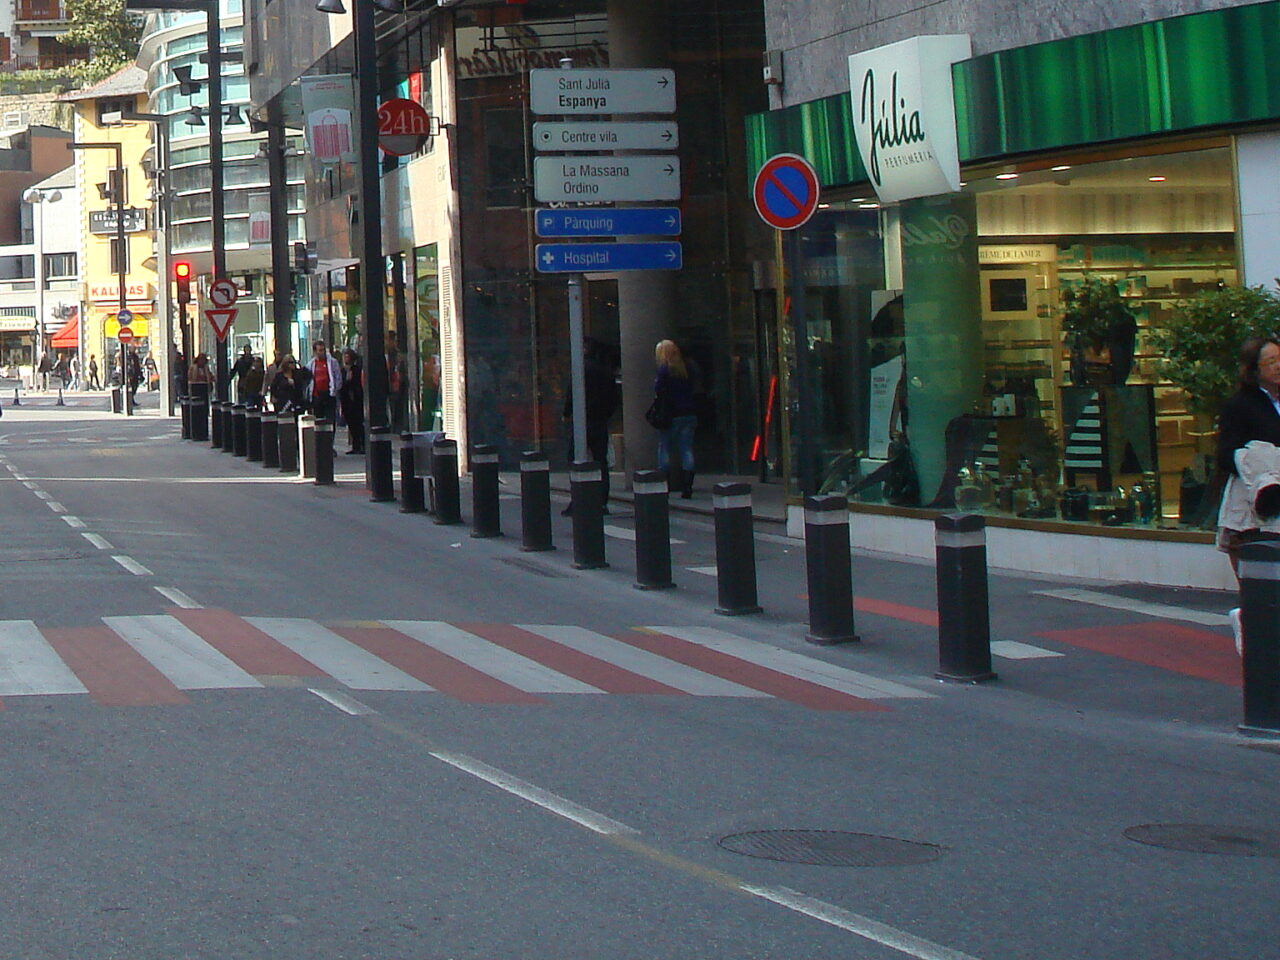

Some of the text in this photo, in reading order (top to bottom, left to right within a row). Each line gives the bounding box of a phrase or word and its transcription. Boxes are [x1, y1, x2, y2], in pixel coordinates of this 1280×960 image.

[559, 78, 582, 89] Sant
[559, 95, 606, 108] Espanya
[378, 109, 426, 135] 24h
[562, 130, 618, 143] Centre vila
[884, 151, 934, 168] PERFUMERIA
[563, 165, 630, 177] La Massana
[564, 181, 599, 194] Ordino
[564, 216, 613, 231] Pàrquing
[564, 252, 609, 266] Hospital
